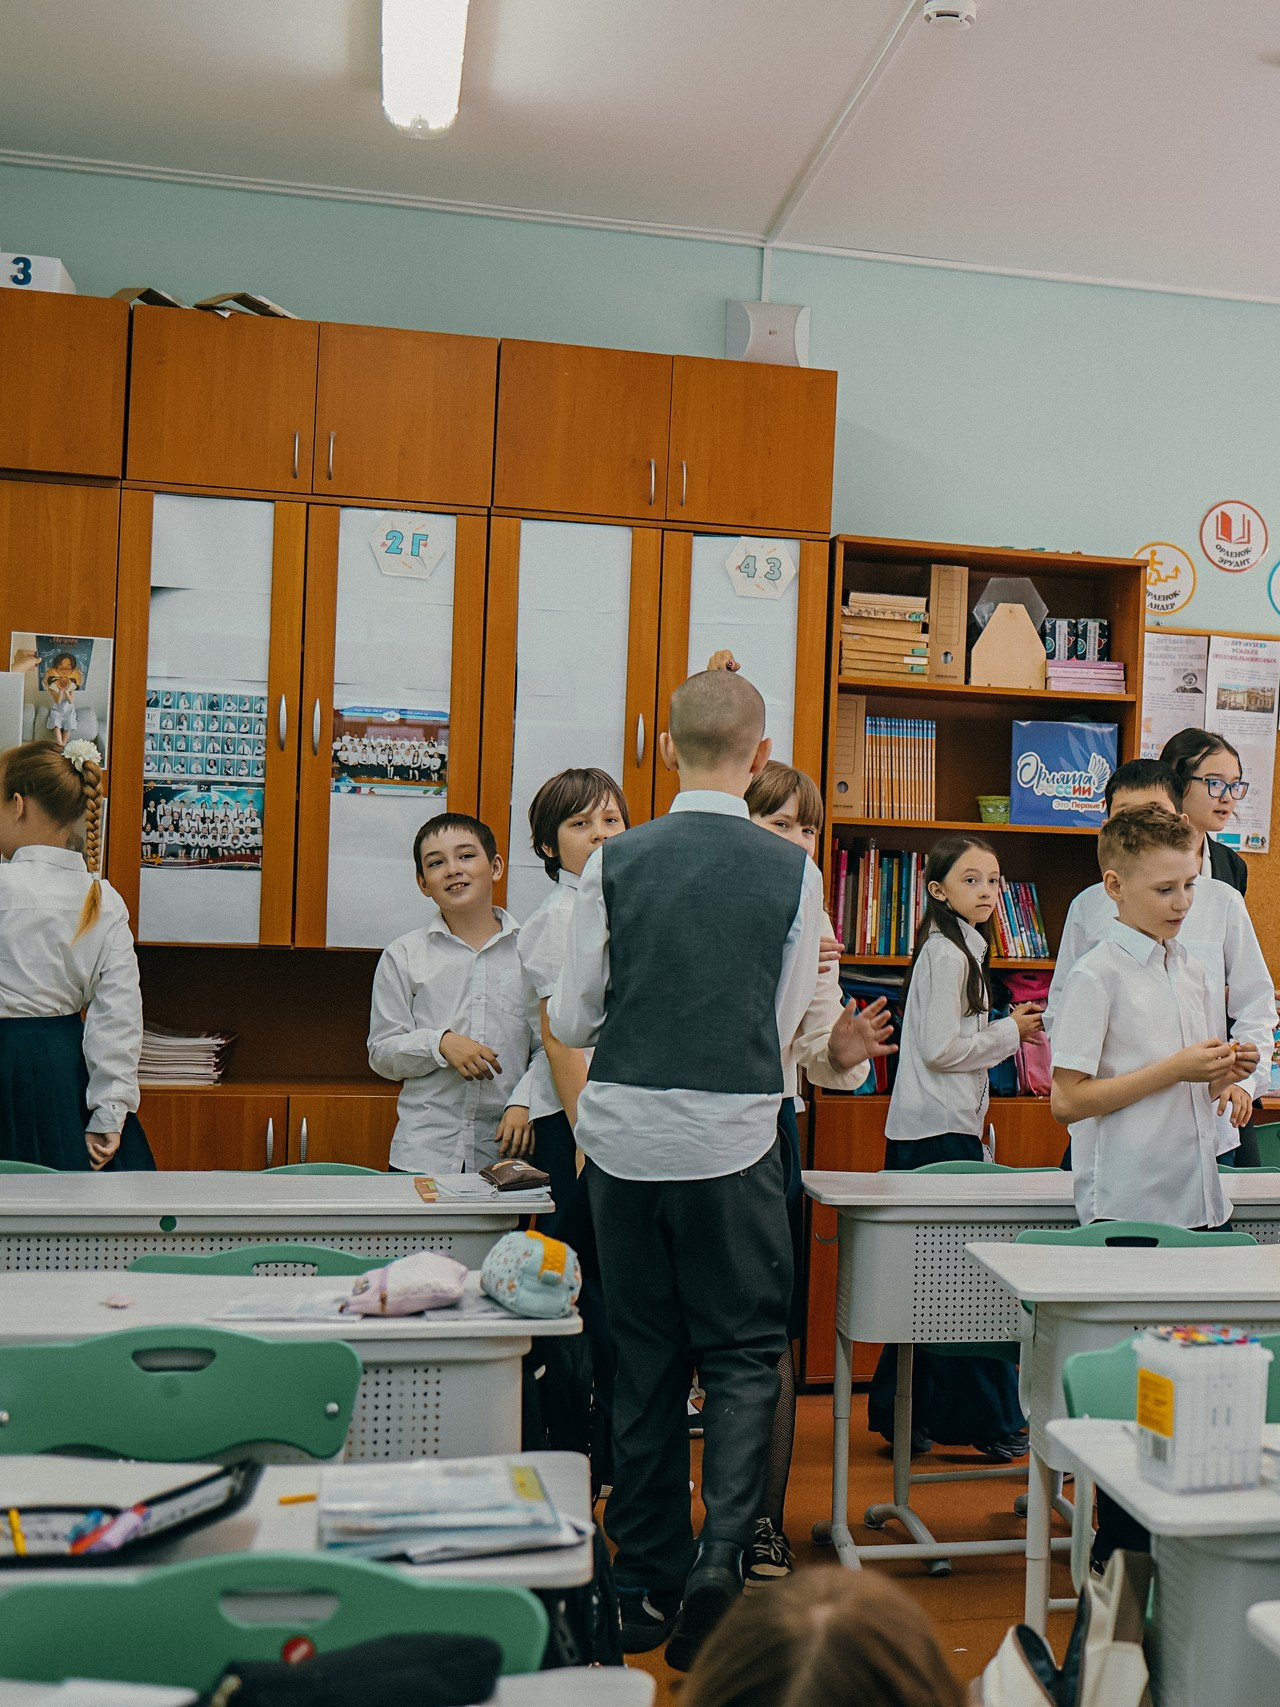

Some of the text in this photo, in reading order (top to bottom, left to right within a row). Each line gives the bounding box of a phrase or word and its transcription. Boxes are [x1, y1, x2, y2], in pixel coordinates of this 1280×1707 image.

[11, 256, 32, 286] 3
[1218, 556, 1251, 568] ЭРУДИТ
[1147, 602, 1176, 611] ЛИДЕР
[1019, 754, 1095, 789] Орлята
[1054, 800, 1069, 808] Это
[1071, 801, 1100, 809] Первые
